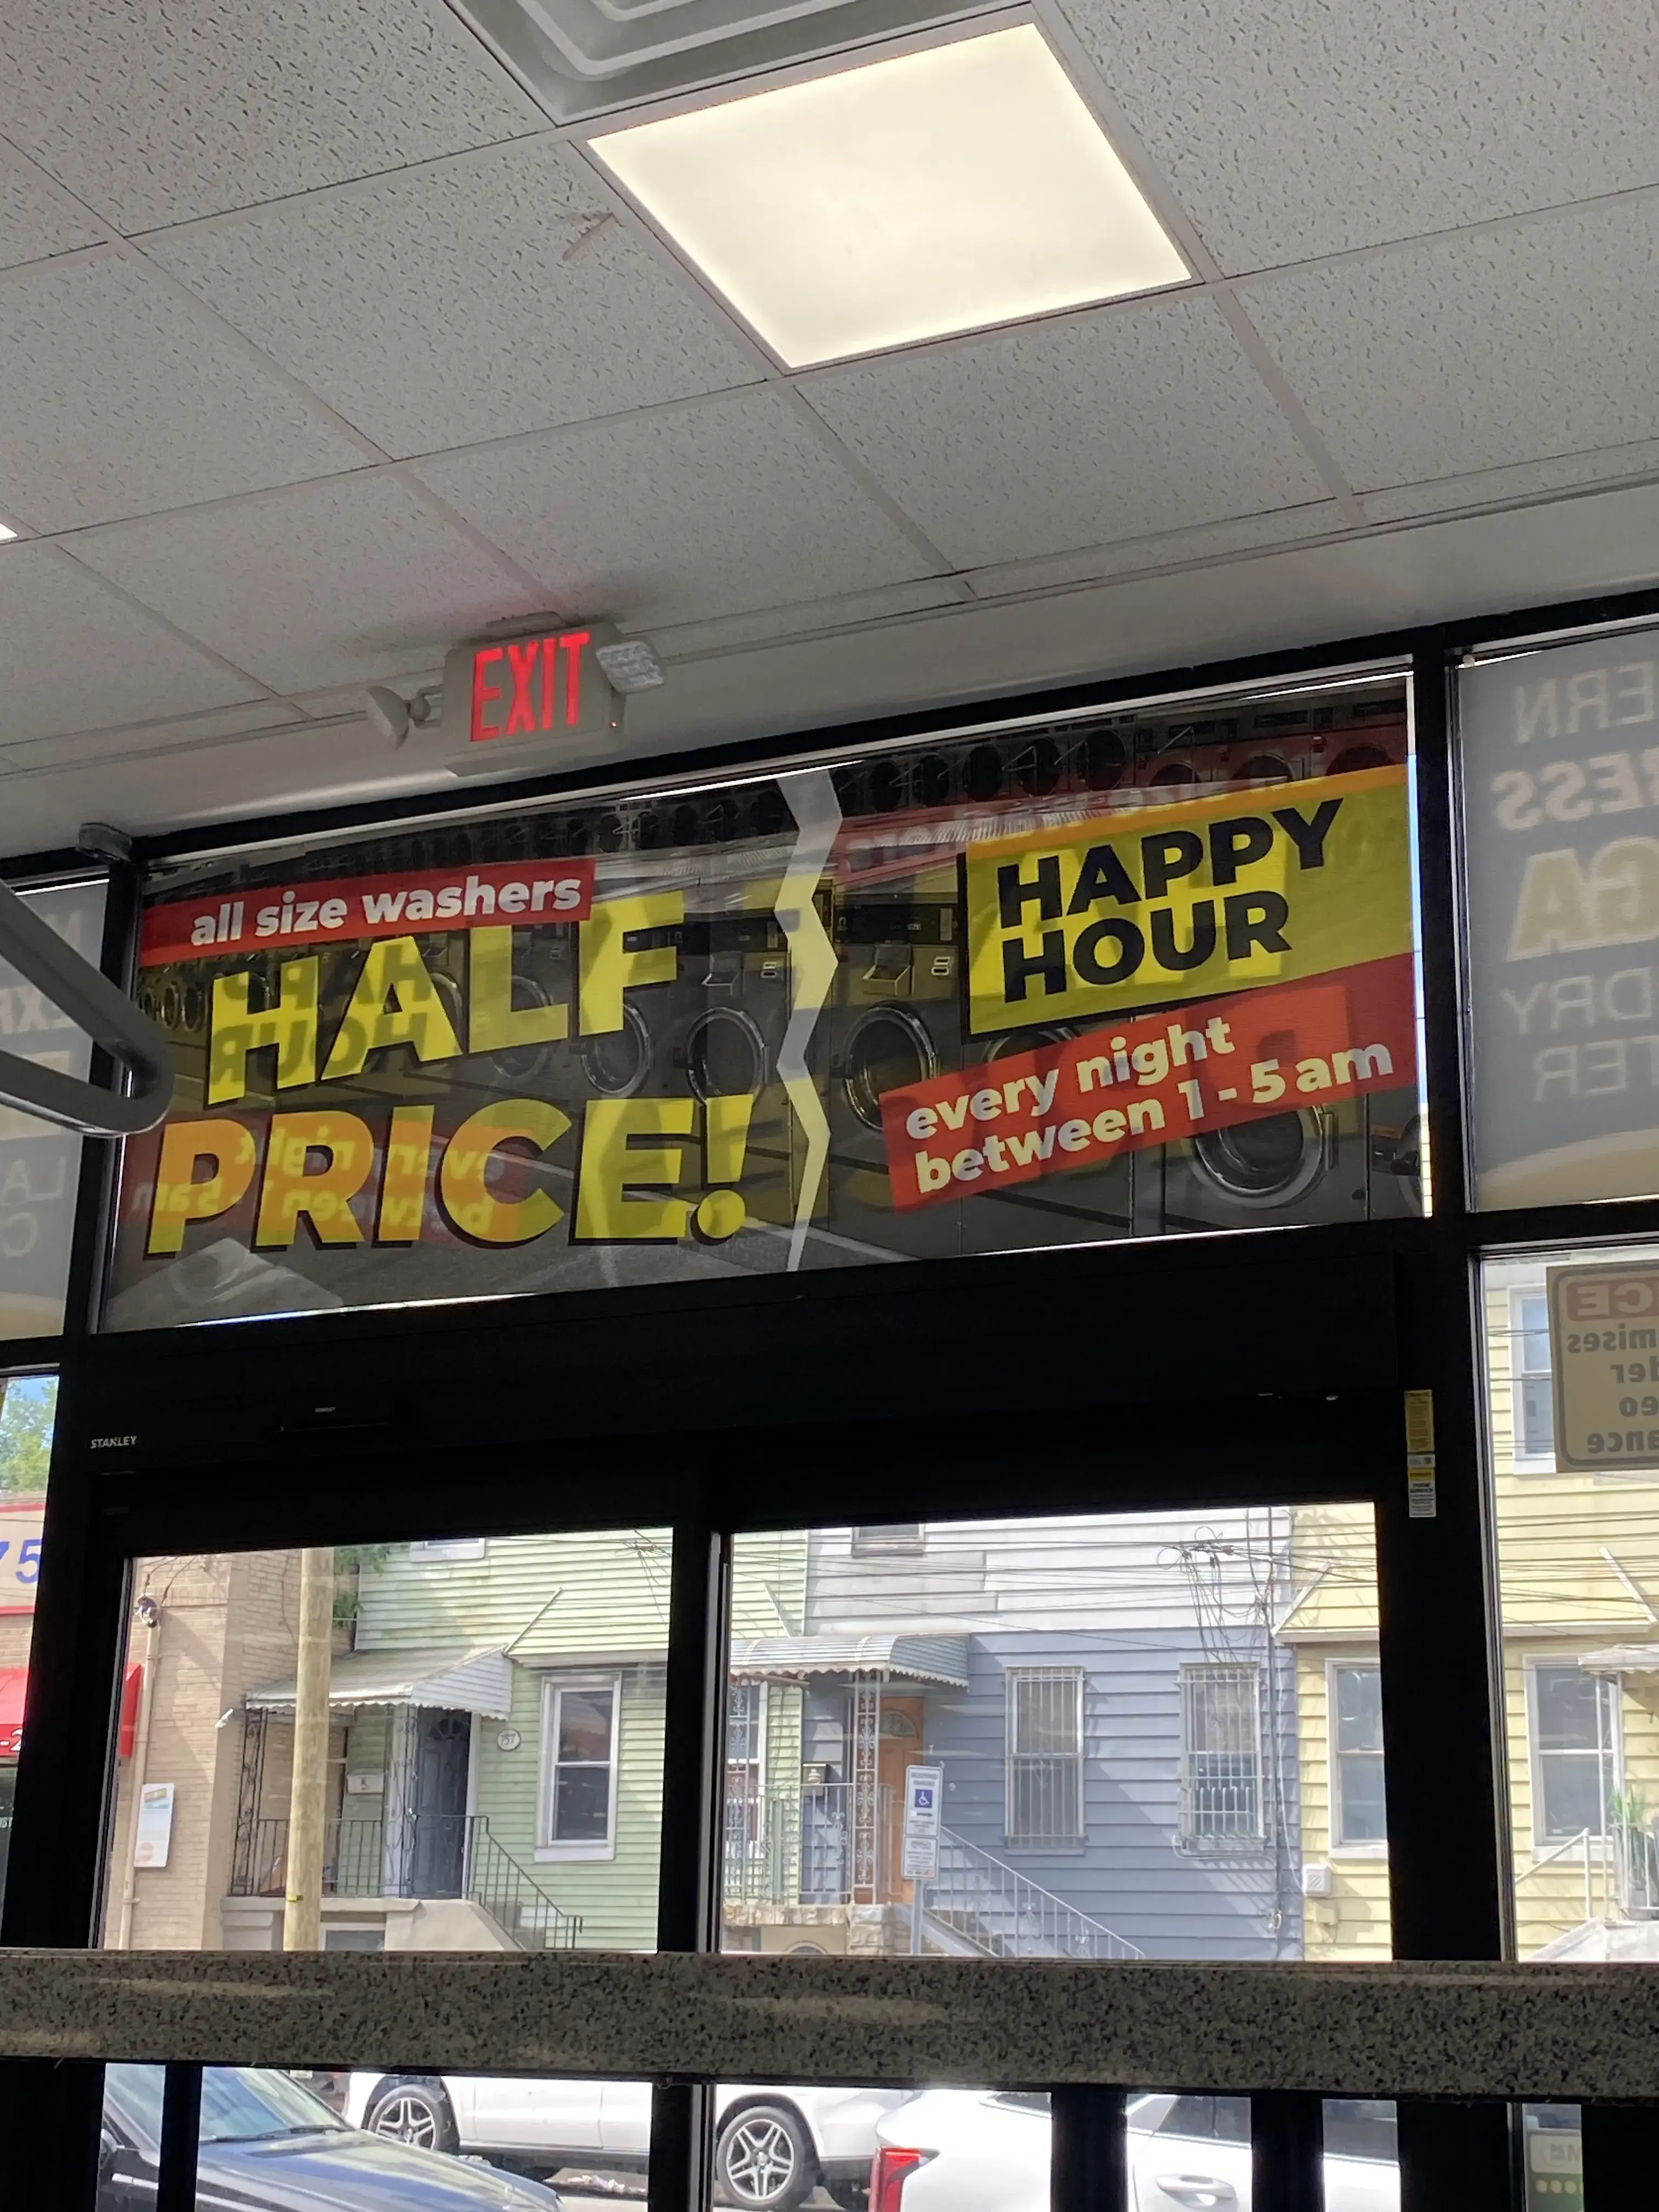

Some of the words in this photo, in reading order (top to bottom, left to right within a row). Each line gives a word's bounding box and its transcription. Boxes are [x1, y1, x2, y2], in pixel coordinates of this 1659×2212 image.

[470, 631, 591, 742] EXIT
[191, 900, 244, 946] all
[256, 890, 347, 937] size
[363, 875, 582, 924] washers
[997, 798, 1344, 928] HAPPY
[208, 891, 684, 1105] HALF
[1003, 890, 1293, 1003] HOUR
[906, 1068, 1059, 1139] every
[1077, 1016, 1236, 1093] night
[145, 1094, 755, 1257] PRICE!
[915, 1097, 1165, 1194] between
[1177, 1079, 1205, 1121] 1
[90, 1435, 137, 1449] STANLEY
